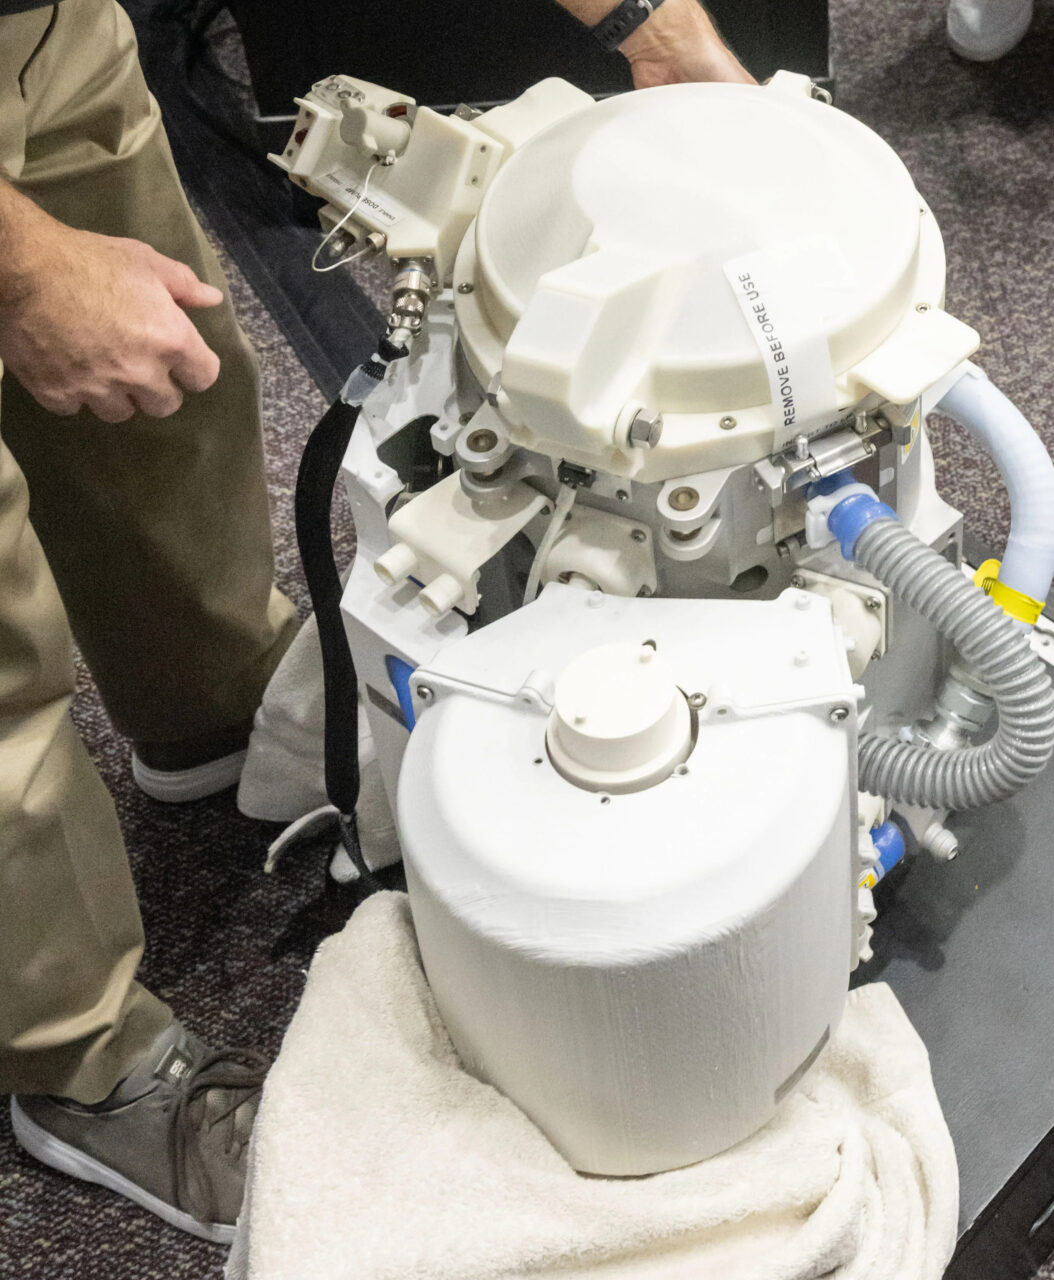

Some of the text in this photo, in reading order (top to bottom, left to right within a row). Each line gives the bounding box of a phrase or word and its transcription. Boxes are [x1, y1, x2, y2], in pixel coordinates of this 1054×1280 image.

[362, 197, 380, 210] DOSE
[738, 271, 797, 427] REMOVE BEFORE USE
